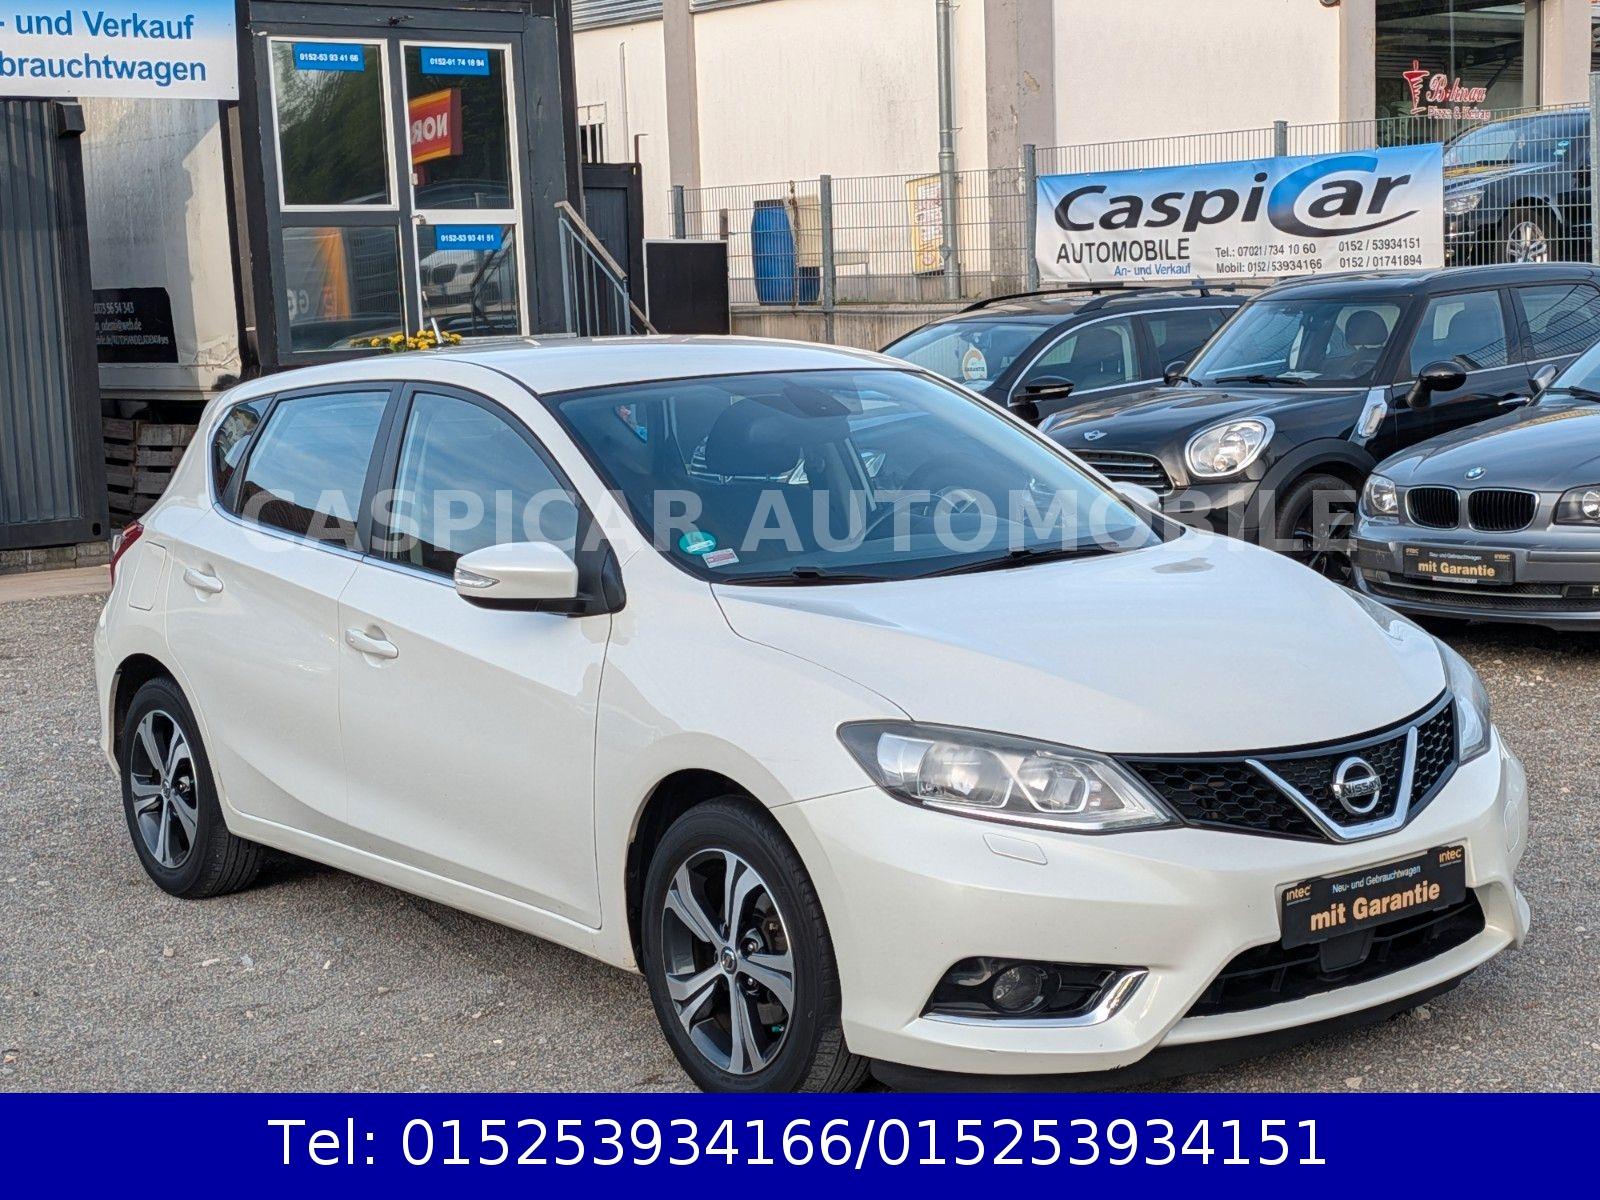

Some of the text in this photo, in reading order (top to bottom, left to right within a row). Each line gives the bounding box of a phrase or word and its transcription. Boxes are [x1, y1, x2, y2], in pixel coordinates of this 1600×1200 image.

[15, 10, 73, 36] und
[81, 10, 195, 40] Verkauf
[0, 51, 206, 87] brauchtwagen
[1054, 155, 1419, 238] CaspiCar
[1056, 238, 1190, 265] AUTOMOBILE
[1215, 246, 1235, 258] Tel.:
[1288, 243, 1300, 255] 10
[1302, 242, 1317, 254] 60
[1338, 240, 1363, 252] 0152
[1372, 237, 1421, 251] 53934151
[1113, 262, 1191, 277] An- und Verkauf
[1216, 261, 1245, 273] Mobil:
[1339, 256, 1364, 268] 0152
[1372, 254, 1422, 267] 01741894
[1418, 560, 1496, 577] mit Garantie
[1344, 779, 1380, 797] NISSAN
[1440, 848, 1463, 863] intec
[1332, 865, 1421, 893] Neu- und Gebrauchtwagen
[1286, 885, 1311, 902] intec
[1310, 880, 1440, 932] mit Garantie
